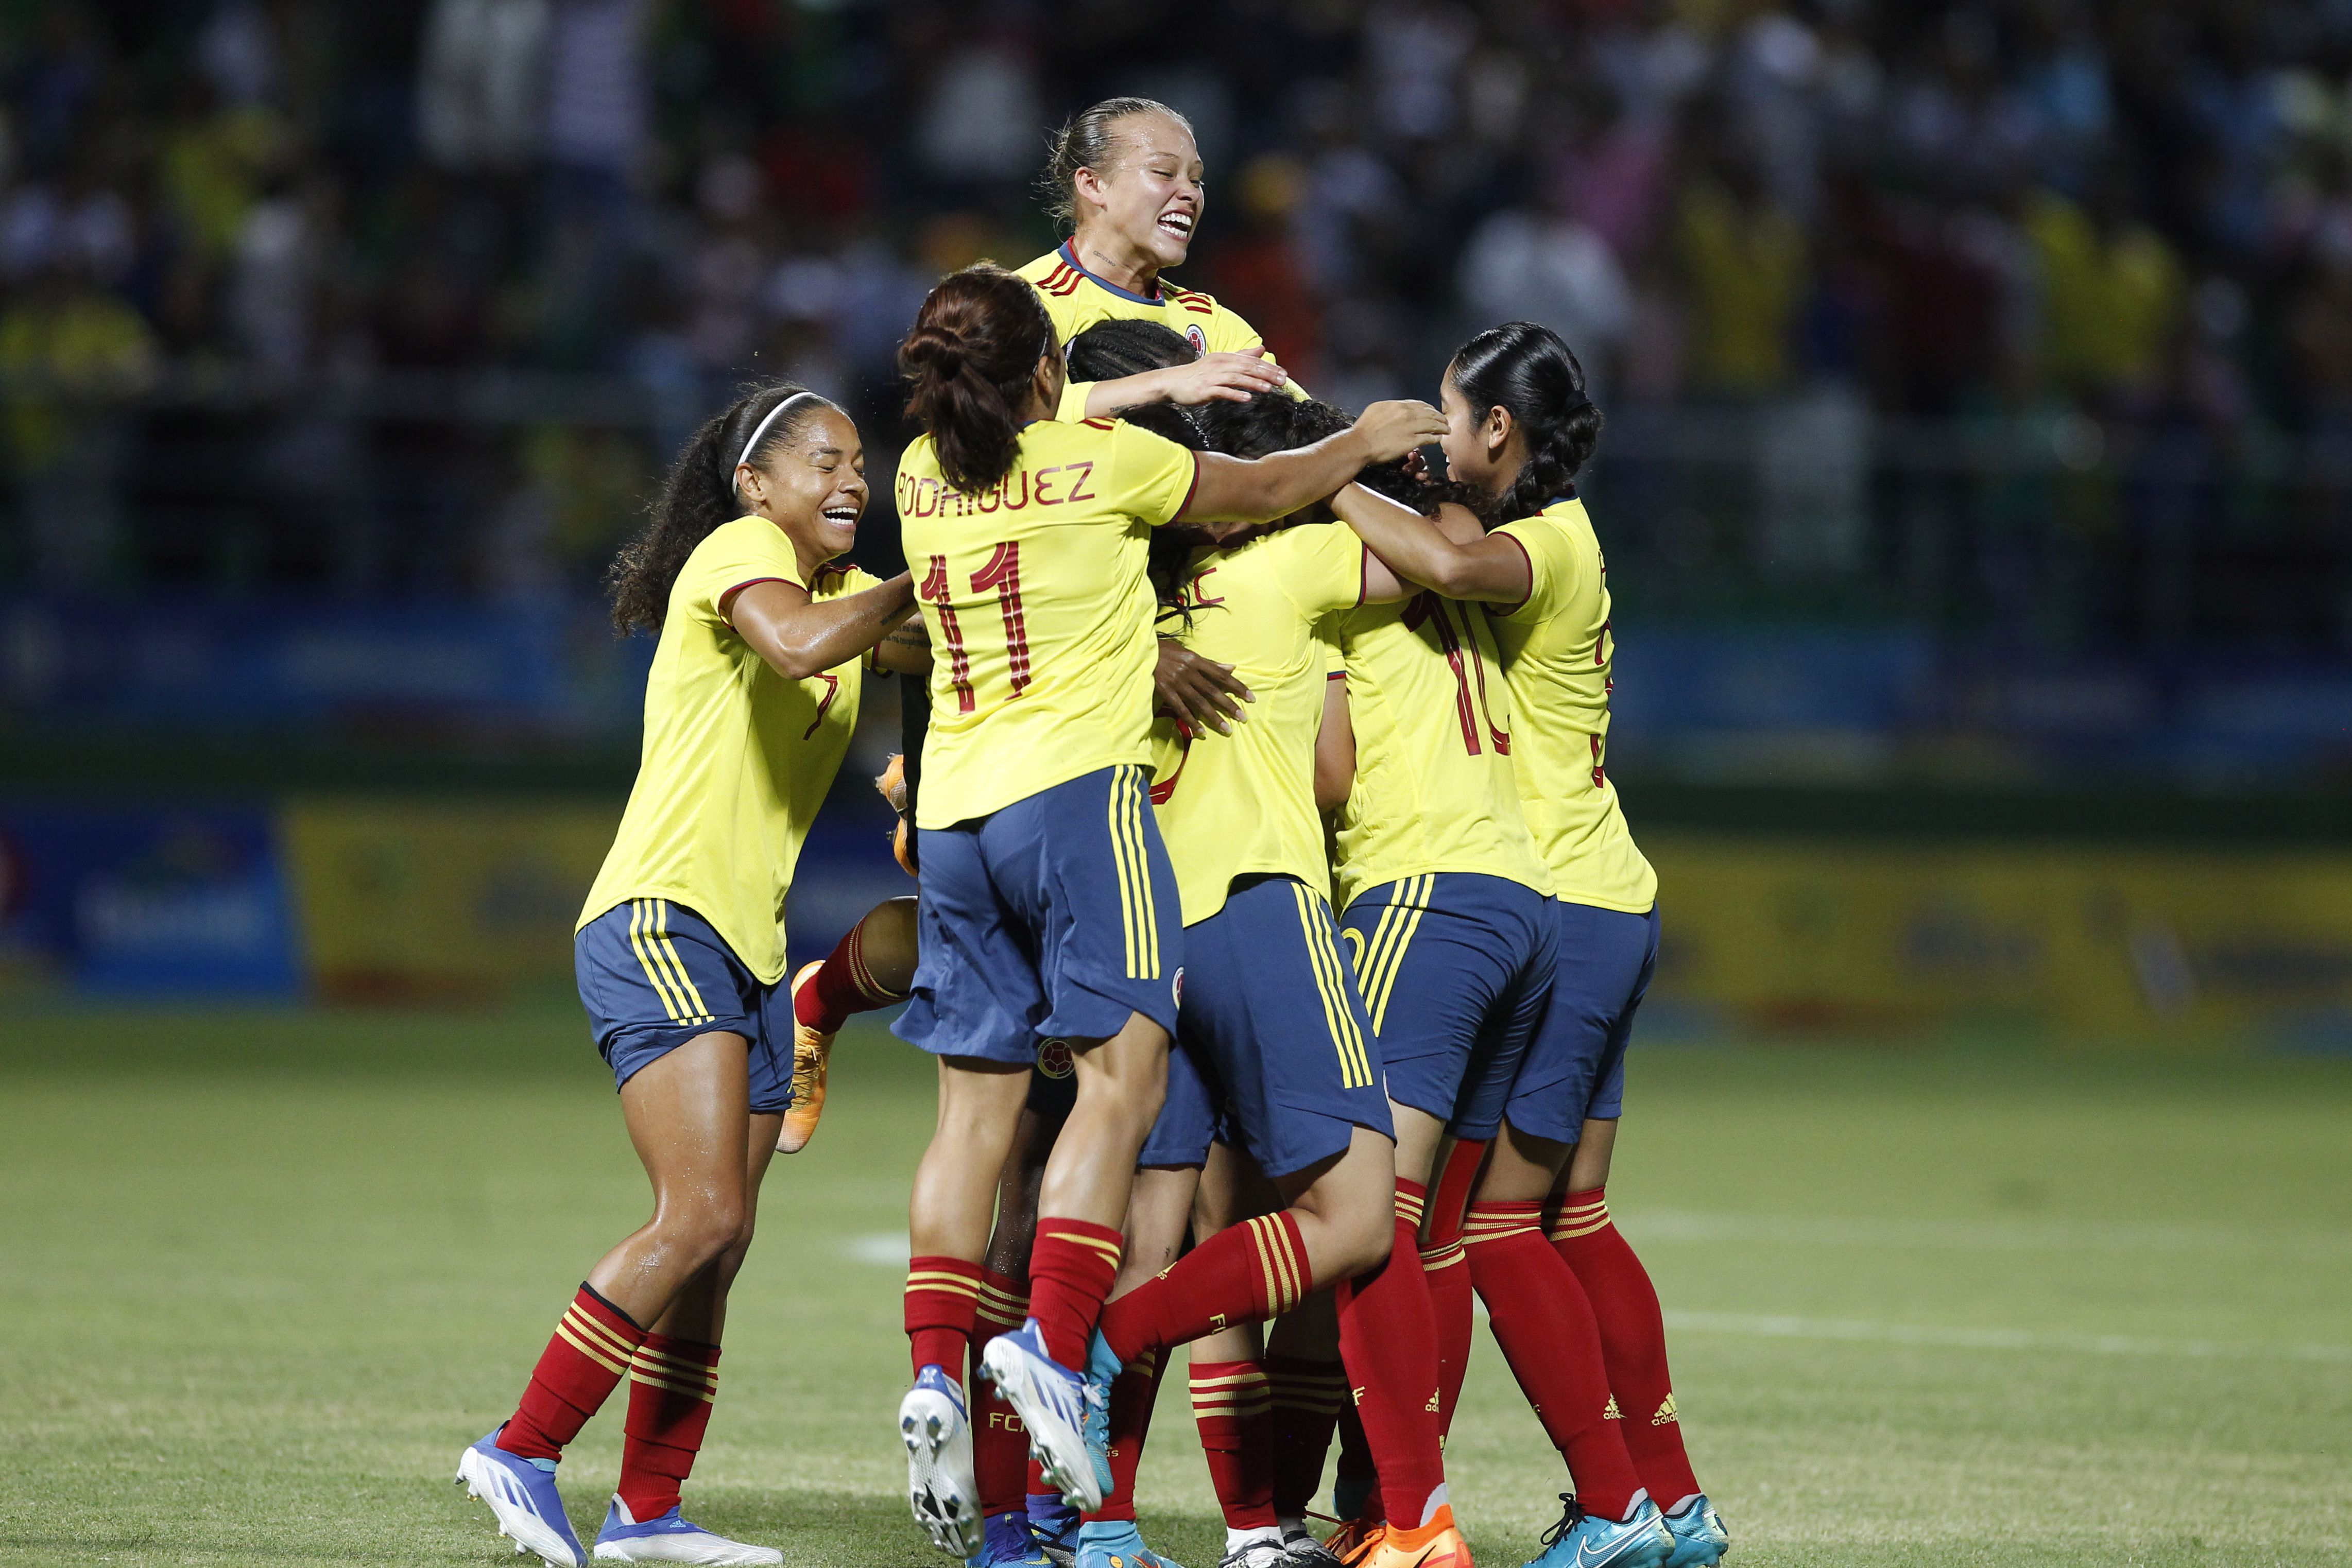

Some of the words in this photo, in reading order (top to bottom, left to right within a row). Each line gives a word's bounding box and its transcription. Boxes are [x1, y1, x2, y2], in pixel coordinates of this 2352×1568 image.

[897, 460, 1095, 518] RODRIGUEZ
[920, 541, 1031, 716] 11
[802, 671, 838, 741] 7
